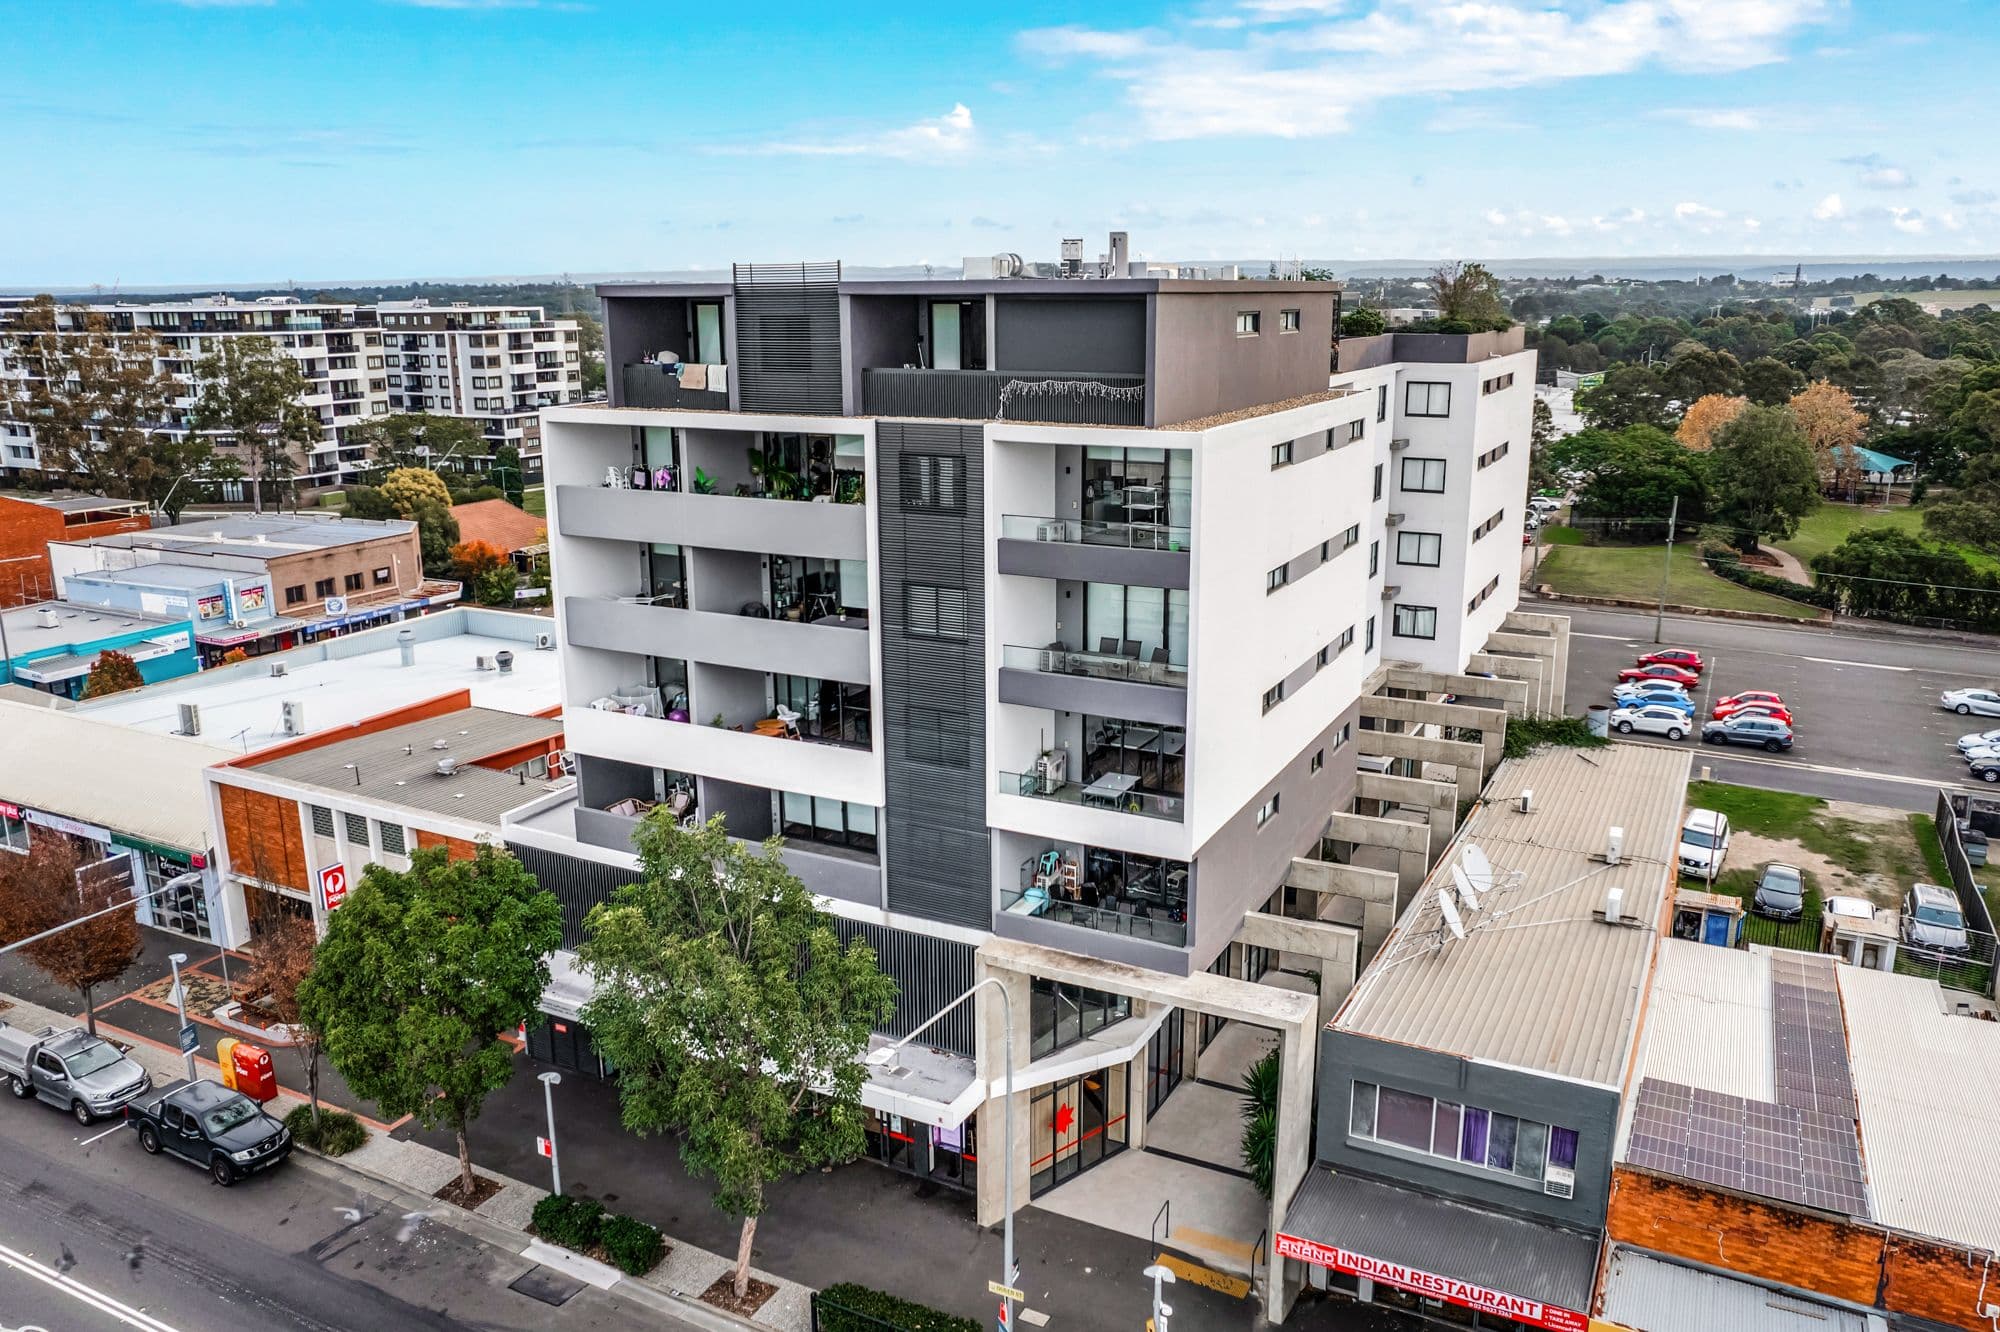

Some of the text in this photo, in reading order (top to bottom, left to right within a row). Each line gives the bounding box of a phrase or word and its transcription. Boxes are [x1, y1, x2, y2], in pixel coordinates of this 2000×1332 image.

[1280, 1241, 1335, 1263] ANAND
[1342, 1253, 1538, 1316] INDIAN RESTAURANT
[1549, 1309, 1563, 1317] DINE
[1549, 1316, 1582, 1327] TAKE AWAY
